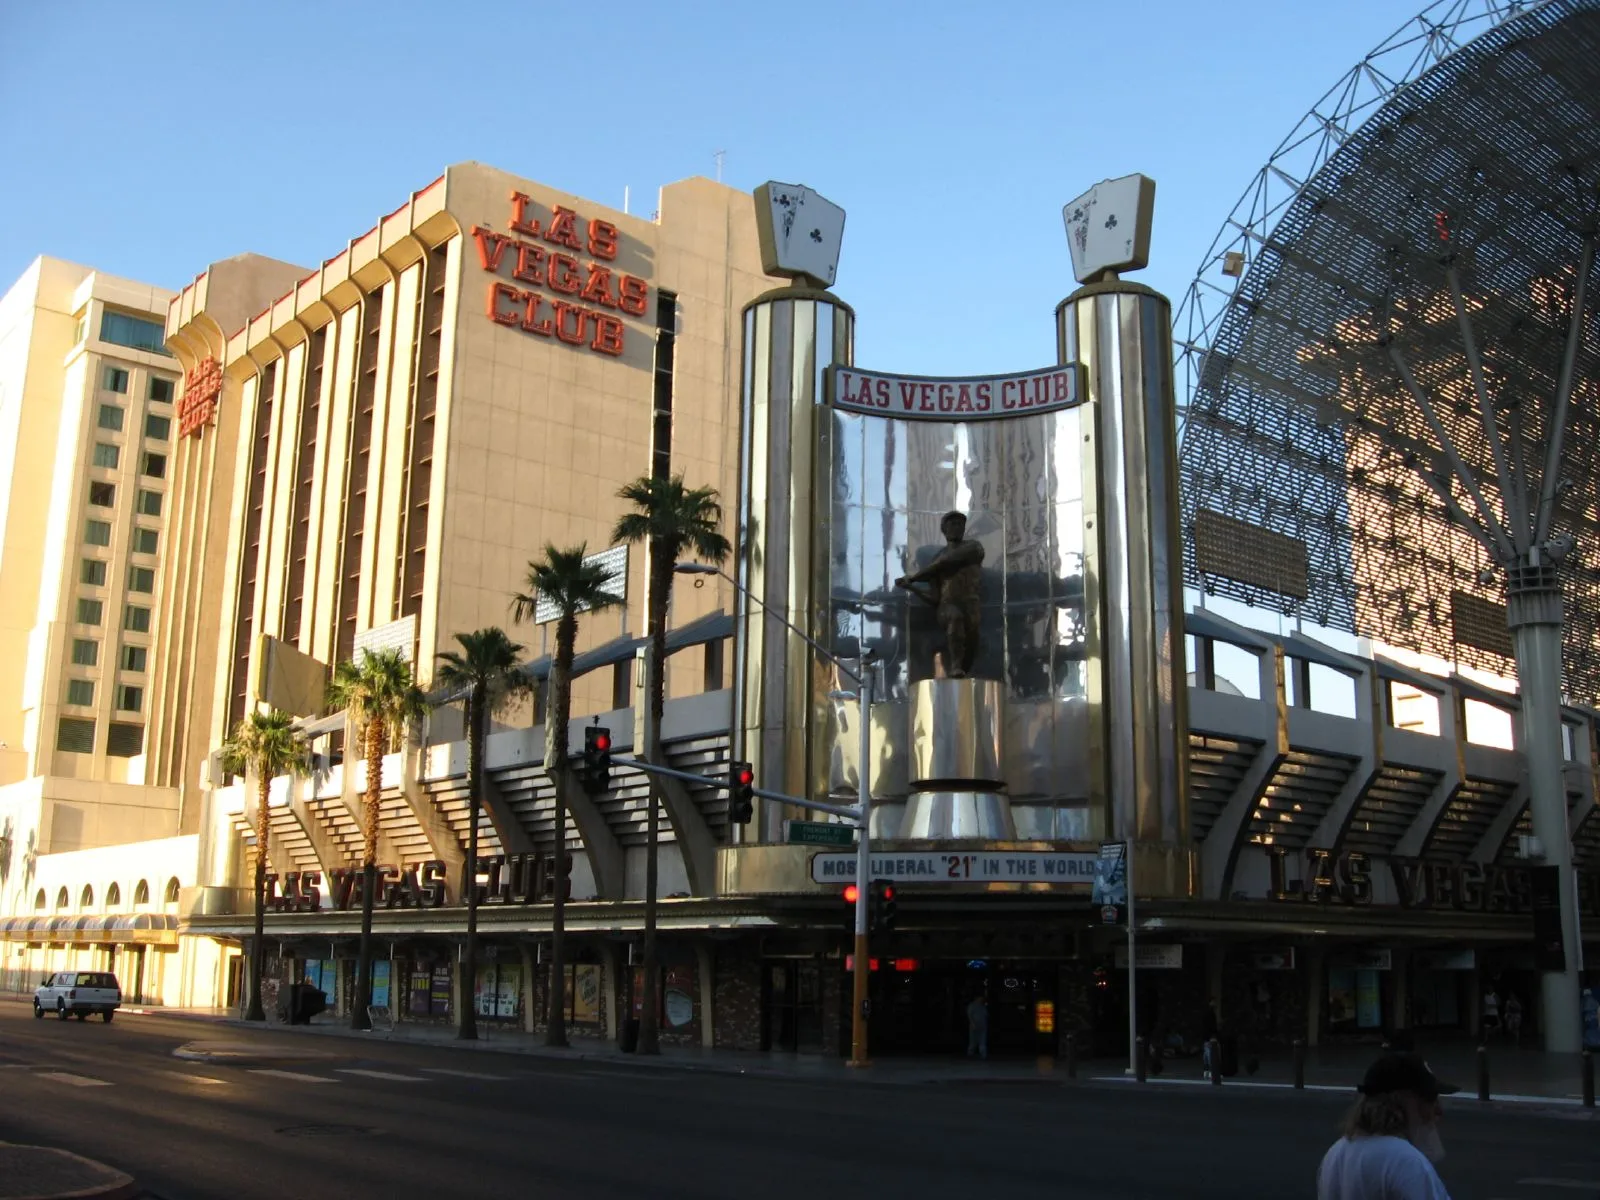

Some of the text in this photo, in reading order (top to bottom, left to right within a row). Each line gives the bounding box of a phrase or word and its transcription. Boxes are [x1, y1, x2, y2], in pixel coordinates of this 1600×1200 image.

[508, 190, 620, 262] LAS
[471, 224, 649, 317] VEGAS
[486, 282, 625, 357] CLUB
[841, 372, 1069, 413] LAS VEGAS CLUB
[265, 869, 321, 913] LAS
[823, 860, 858, 876] MOS
[871, 859, 937, 876] LIBERAL
[983, 859, 1000, 875] IN
[1006, 859, 1037, 876] THE
[1043, 859, 1096, 876] WORLD
[1265, 848, 1373, 908] LAS
